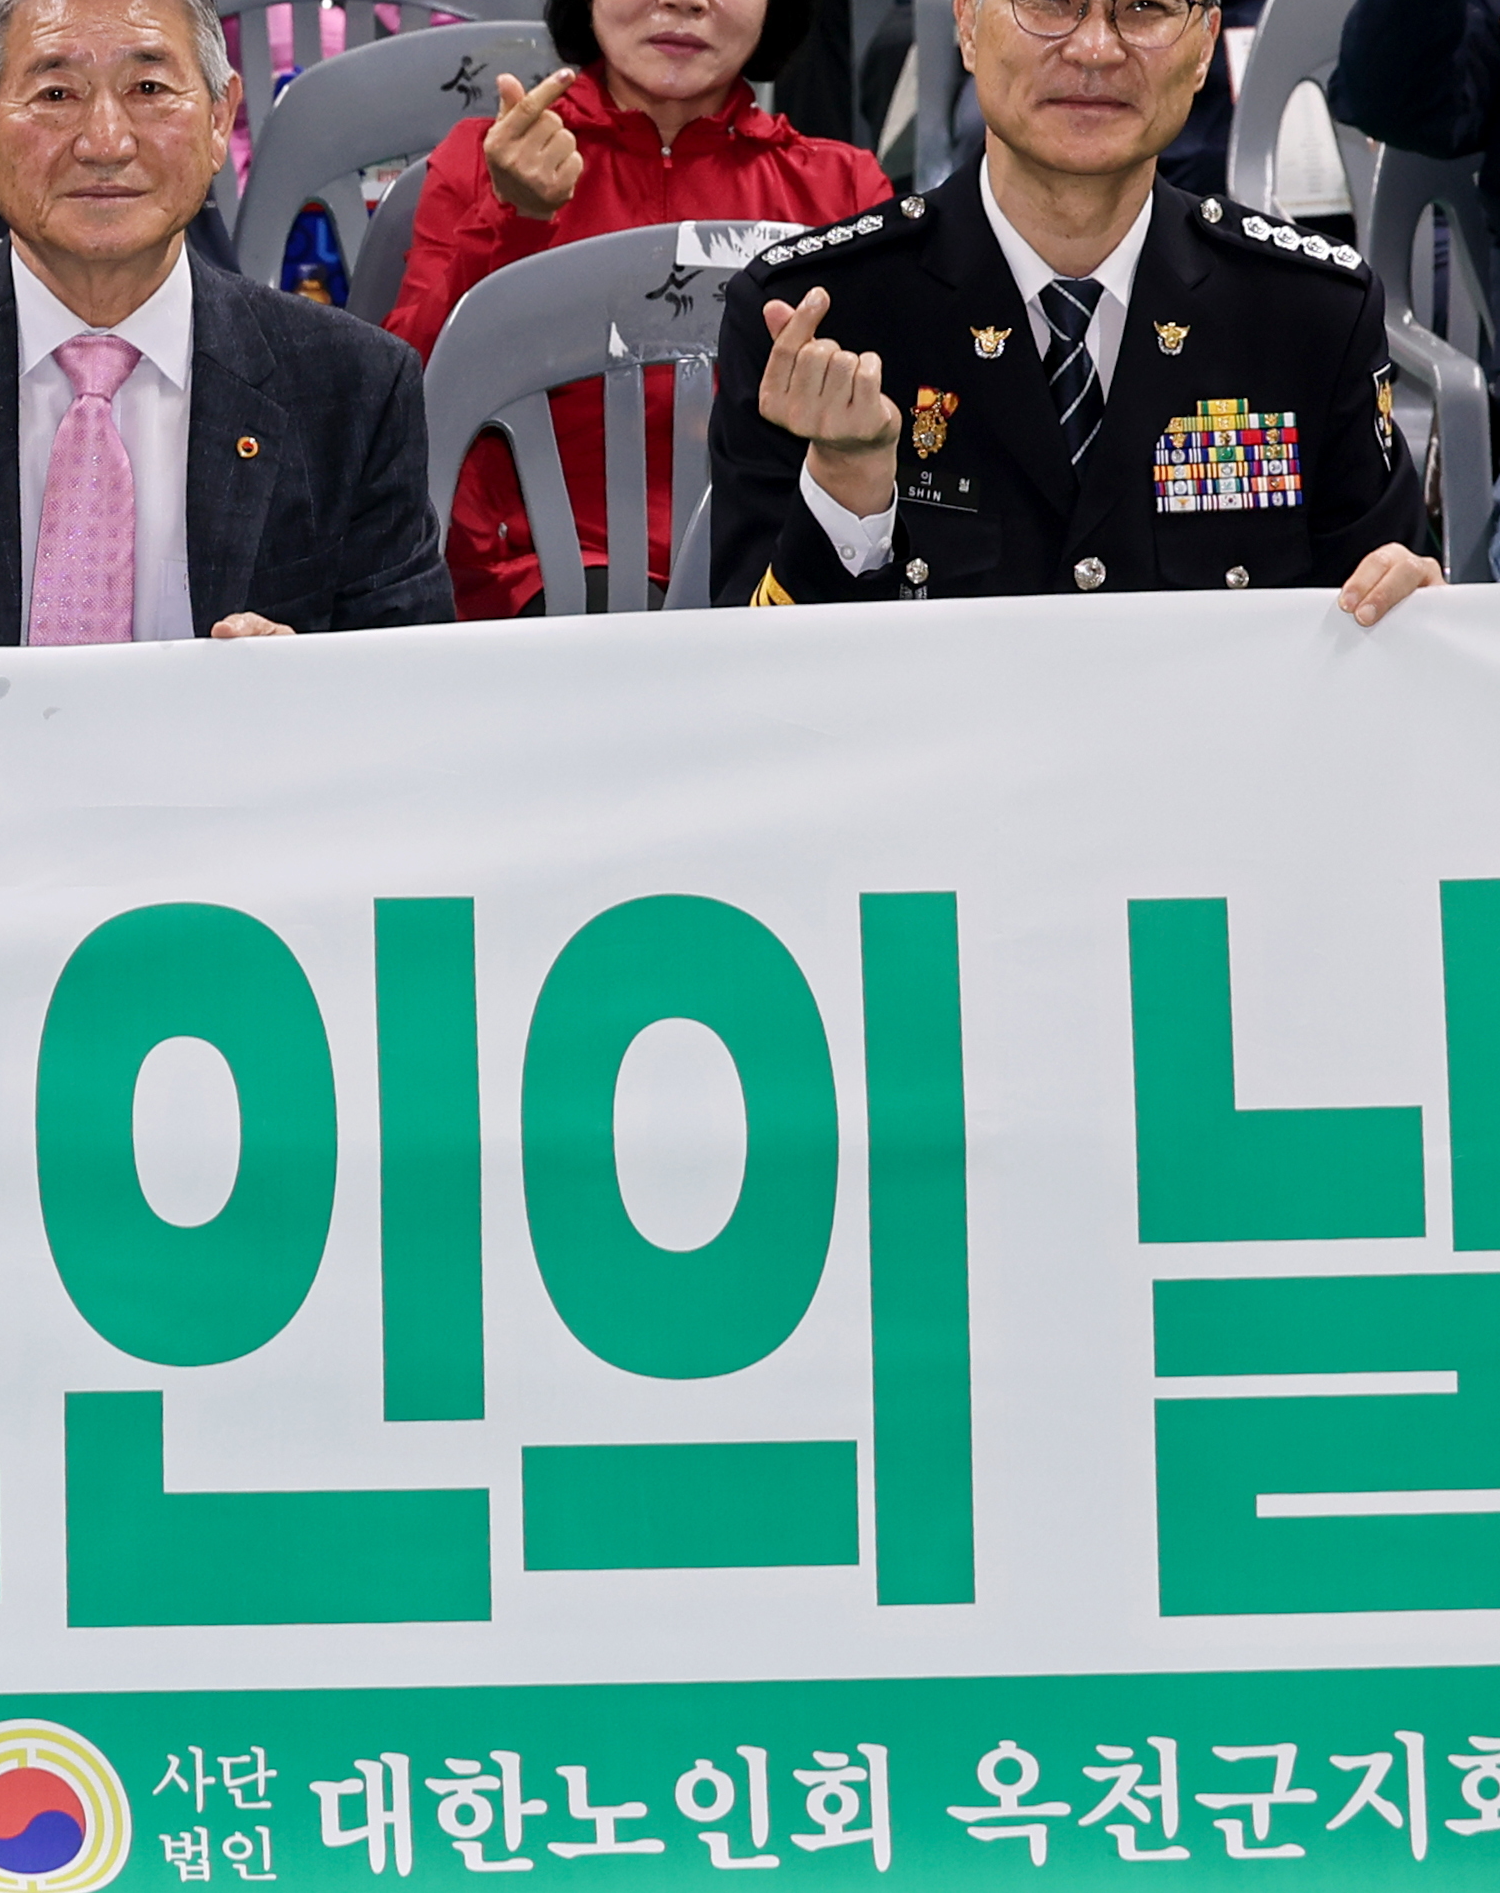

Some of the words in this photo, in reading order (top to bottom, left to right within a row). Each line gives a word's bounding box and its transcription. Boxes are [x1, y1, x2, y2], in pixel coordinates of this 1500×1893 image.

[908, 485, 942, 502] SHIN
[152, 1744, 279, 1814] 사단
[308, 1741, 893, 1878] 대한노인회
[158, 1824, 279, 1884] 법인
